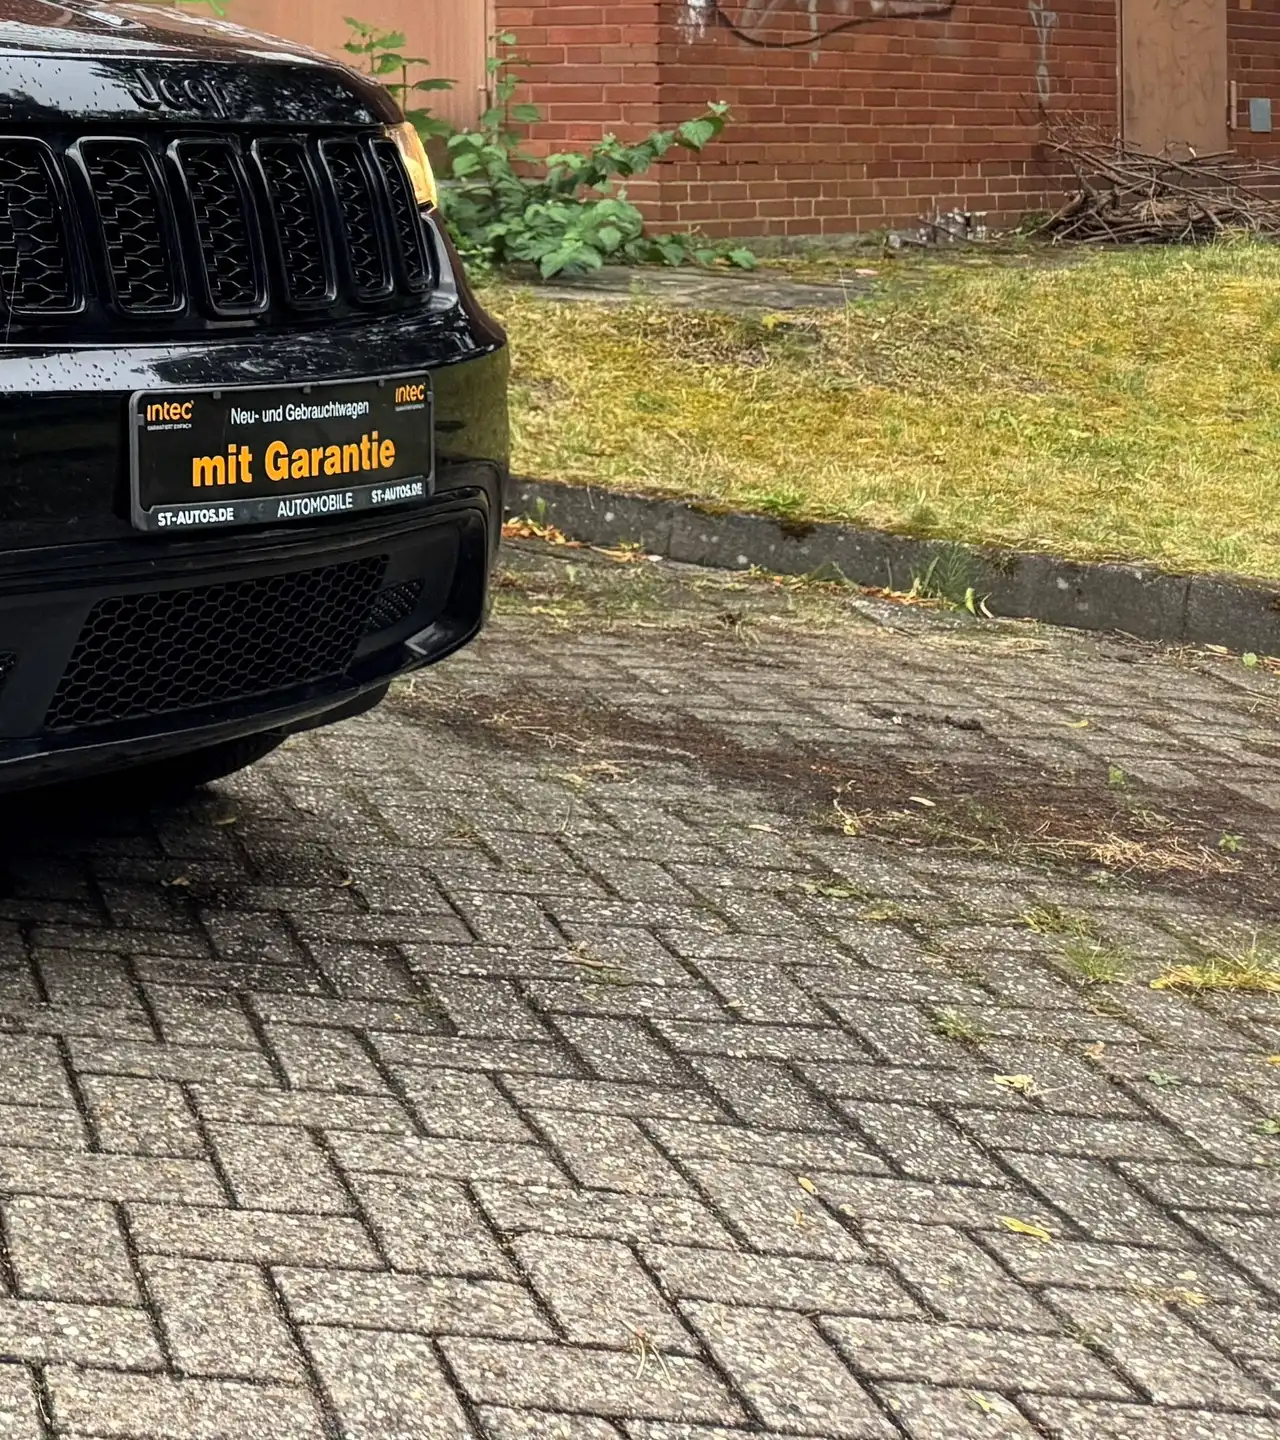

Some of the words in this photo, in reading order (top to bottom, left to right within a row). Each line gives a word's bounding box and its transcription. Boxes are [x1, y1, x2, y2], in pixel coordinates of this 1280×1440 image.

[128, 68, 231, 119] Jeep
[395, 384, 425, 403] intec
[147, 401, 192, 421] intec
[230, 407, 260, 425] Neu-
[262, 405, 283, 422] und
[285, 400, 369, 422] Gebrauchtwagen
[192, 443, 253, 487] mit
[264, 430, 396, 482] Garantie
[277, 492, 354, 518] AUTOMOBILE
[371, 481, 423, 505] ST-AUTOS.DE
[157, 506, 235, 527] ST-AUTOS.DE
